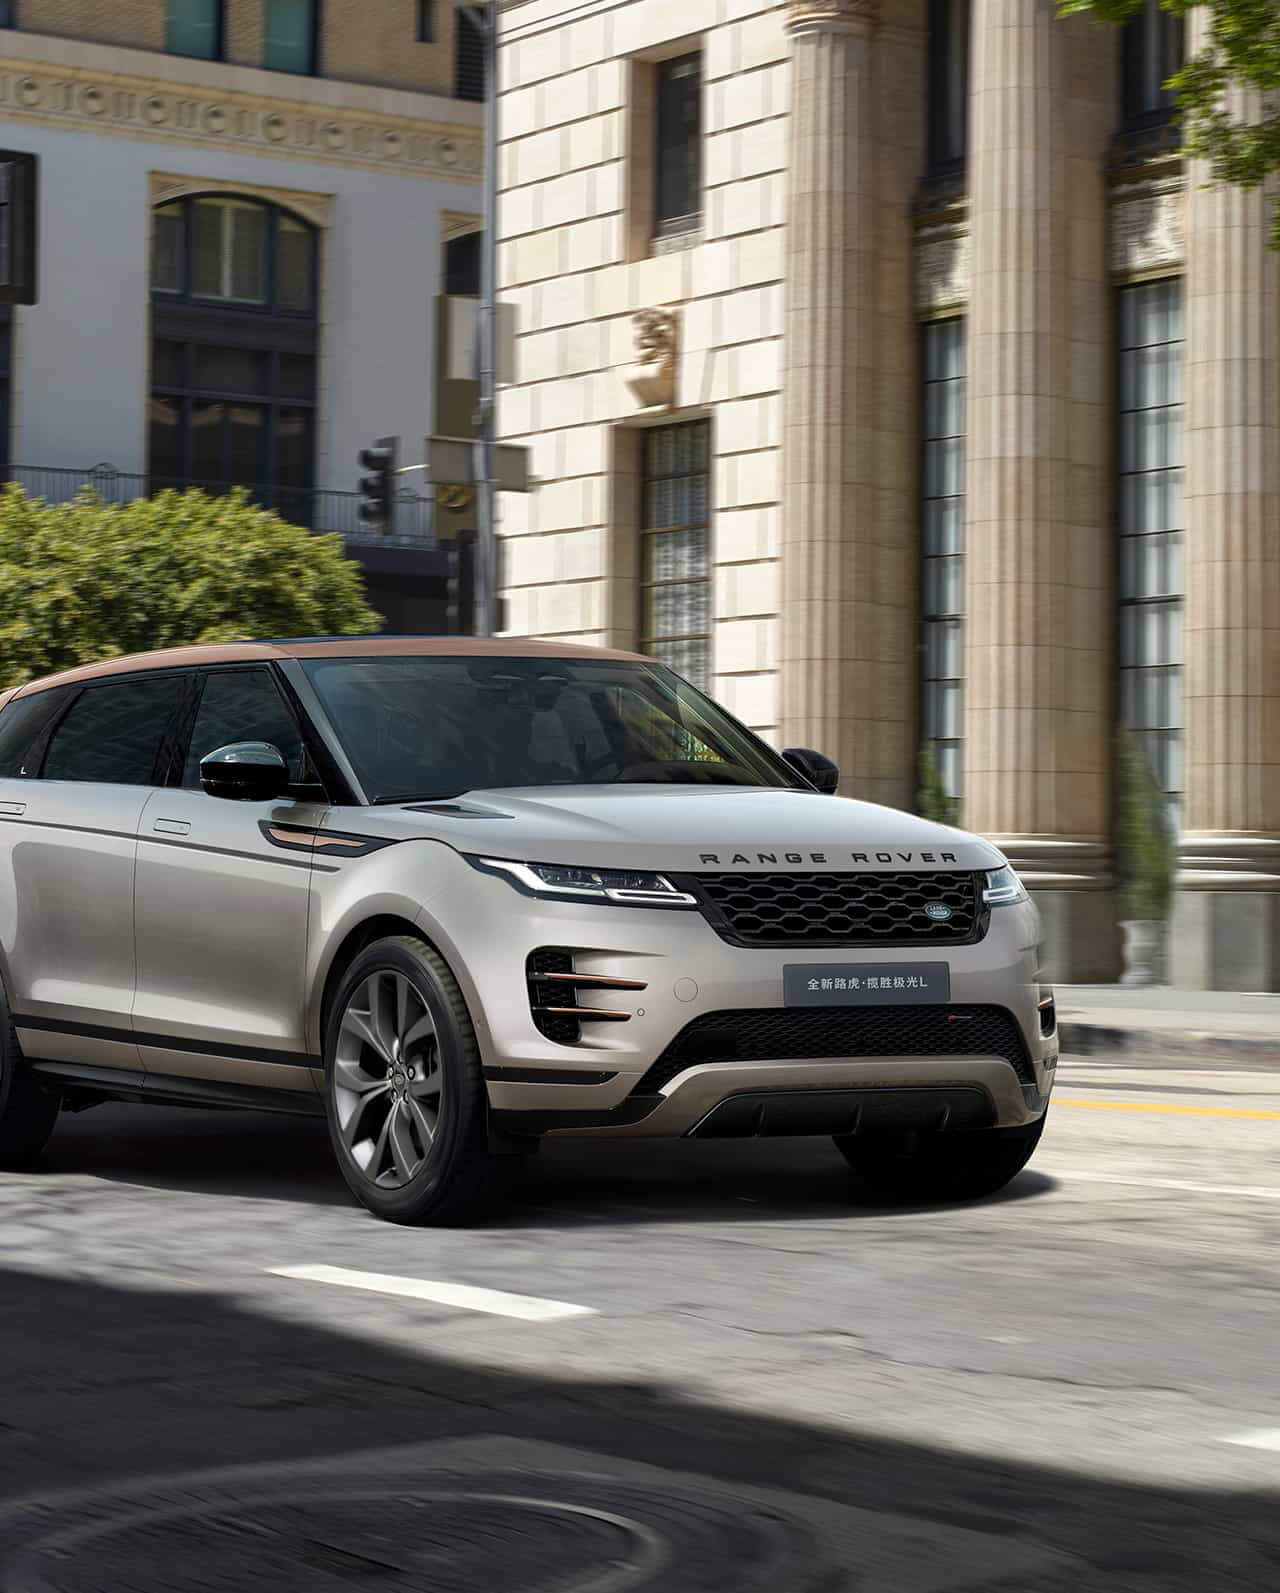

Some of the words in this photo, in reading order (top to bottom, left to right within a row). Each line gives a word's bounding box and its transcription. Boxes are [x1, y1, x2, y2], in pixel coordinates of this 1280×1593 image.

[698, 852, 828, 865] RANGE
[851, 852, 958, 864] ROVER
[807, 975, 929, 991] 全新路虎·揽胜极光L
